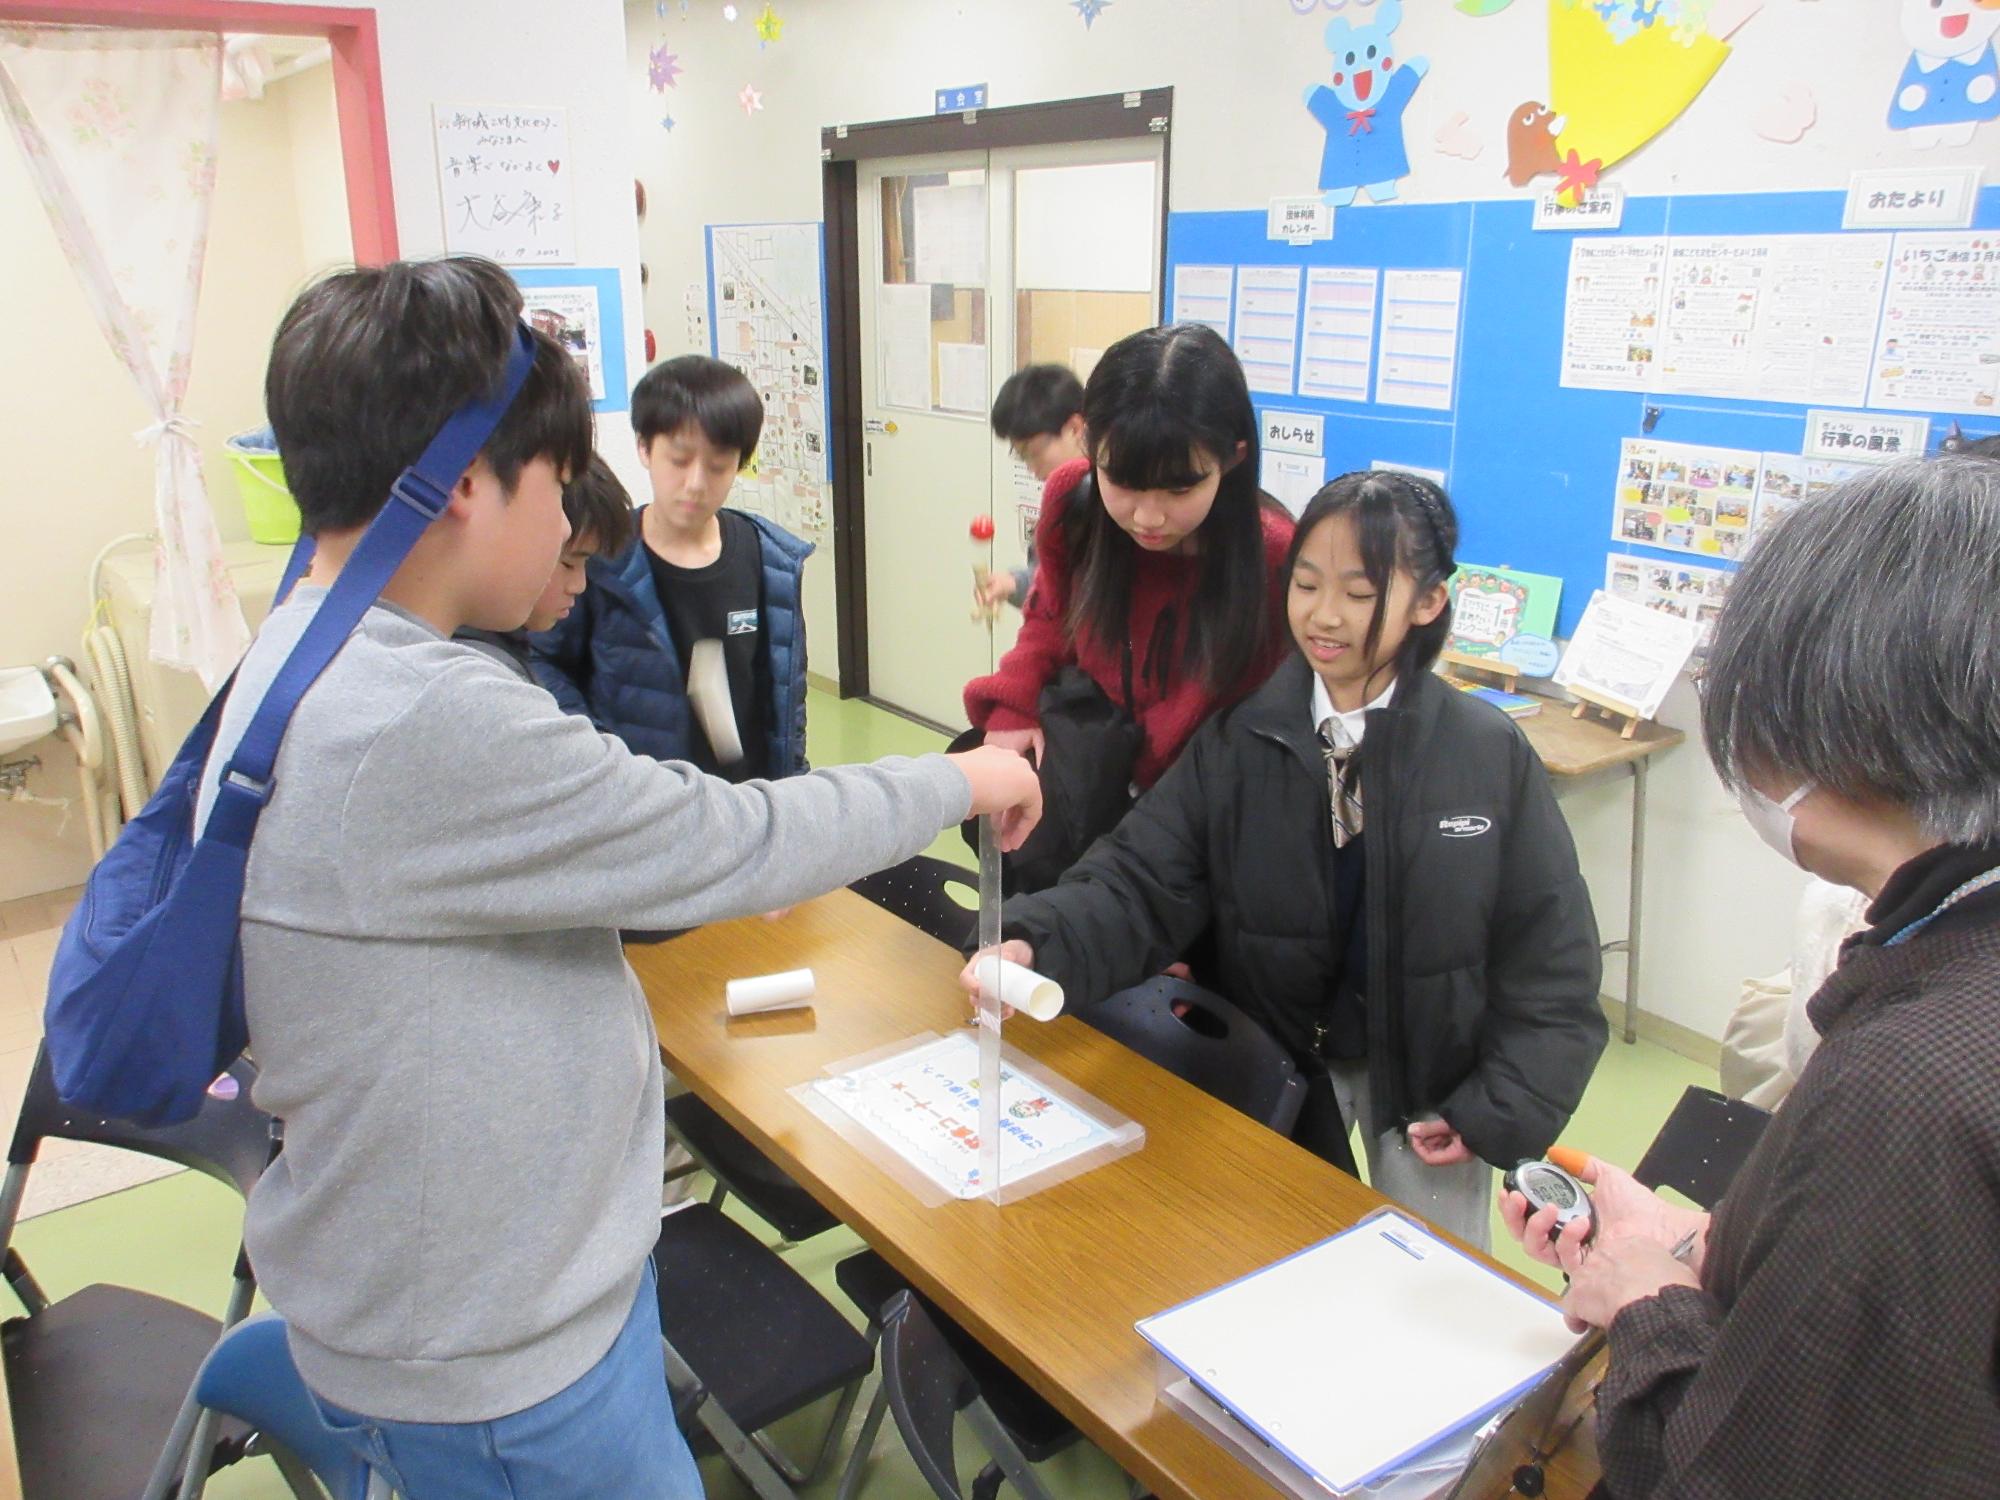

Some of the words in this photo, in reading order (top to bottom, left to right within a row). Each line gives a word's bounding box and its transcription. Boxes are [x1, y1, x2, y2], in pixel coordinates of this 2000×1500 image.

[938, 90, 983, 109] 集会室
[1868, 190, 1945, 209] おたより
[1281, 224, 1317, 233] カレンダー
[1270, 425, 1314, 444] おしらせ
[1821, 431, 1902, 452] 行事の風景
